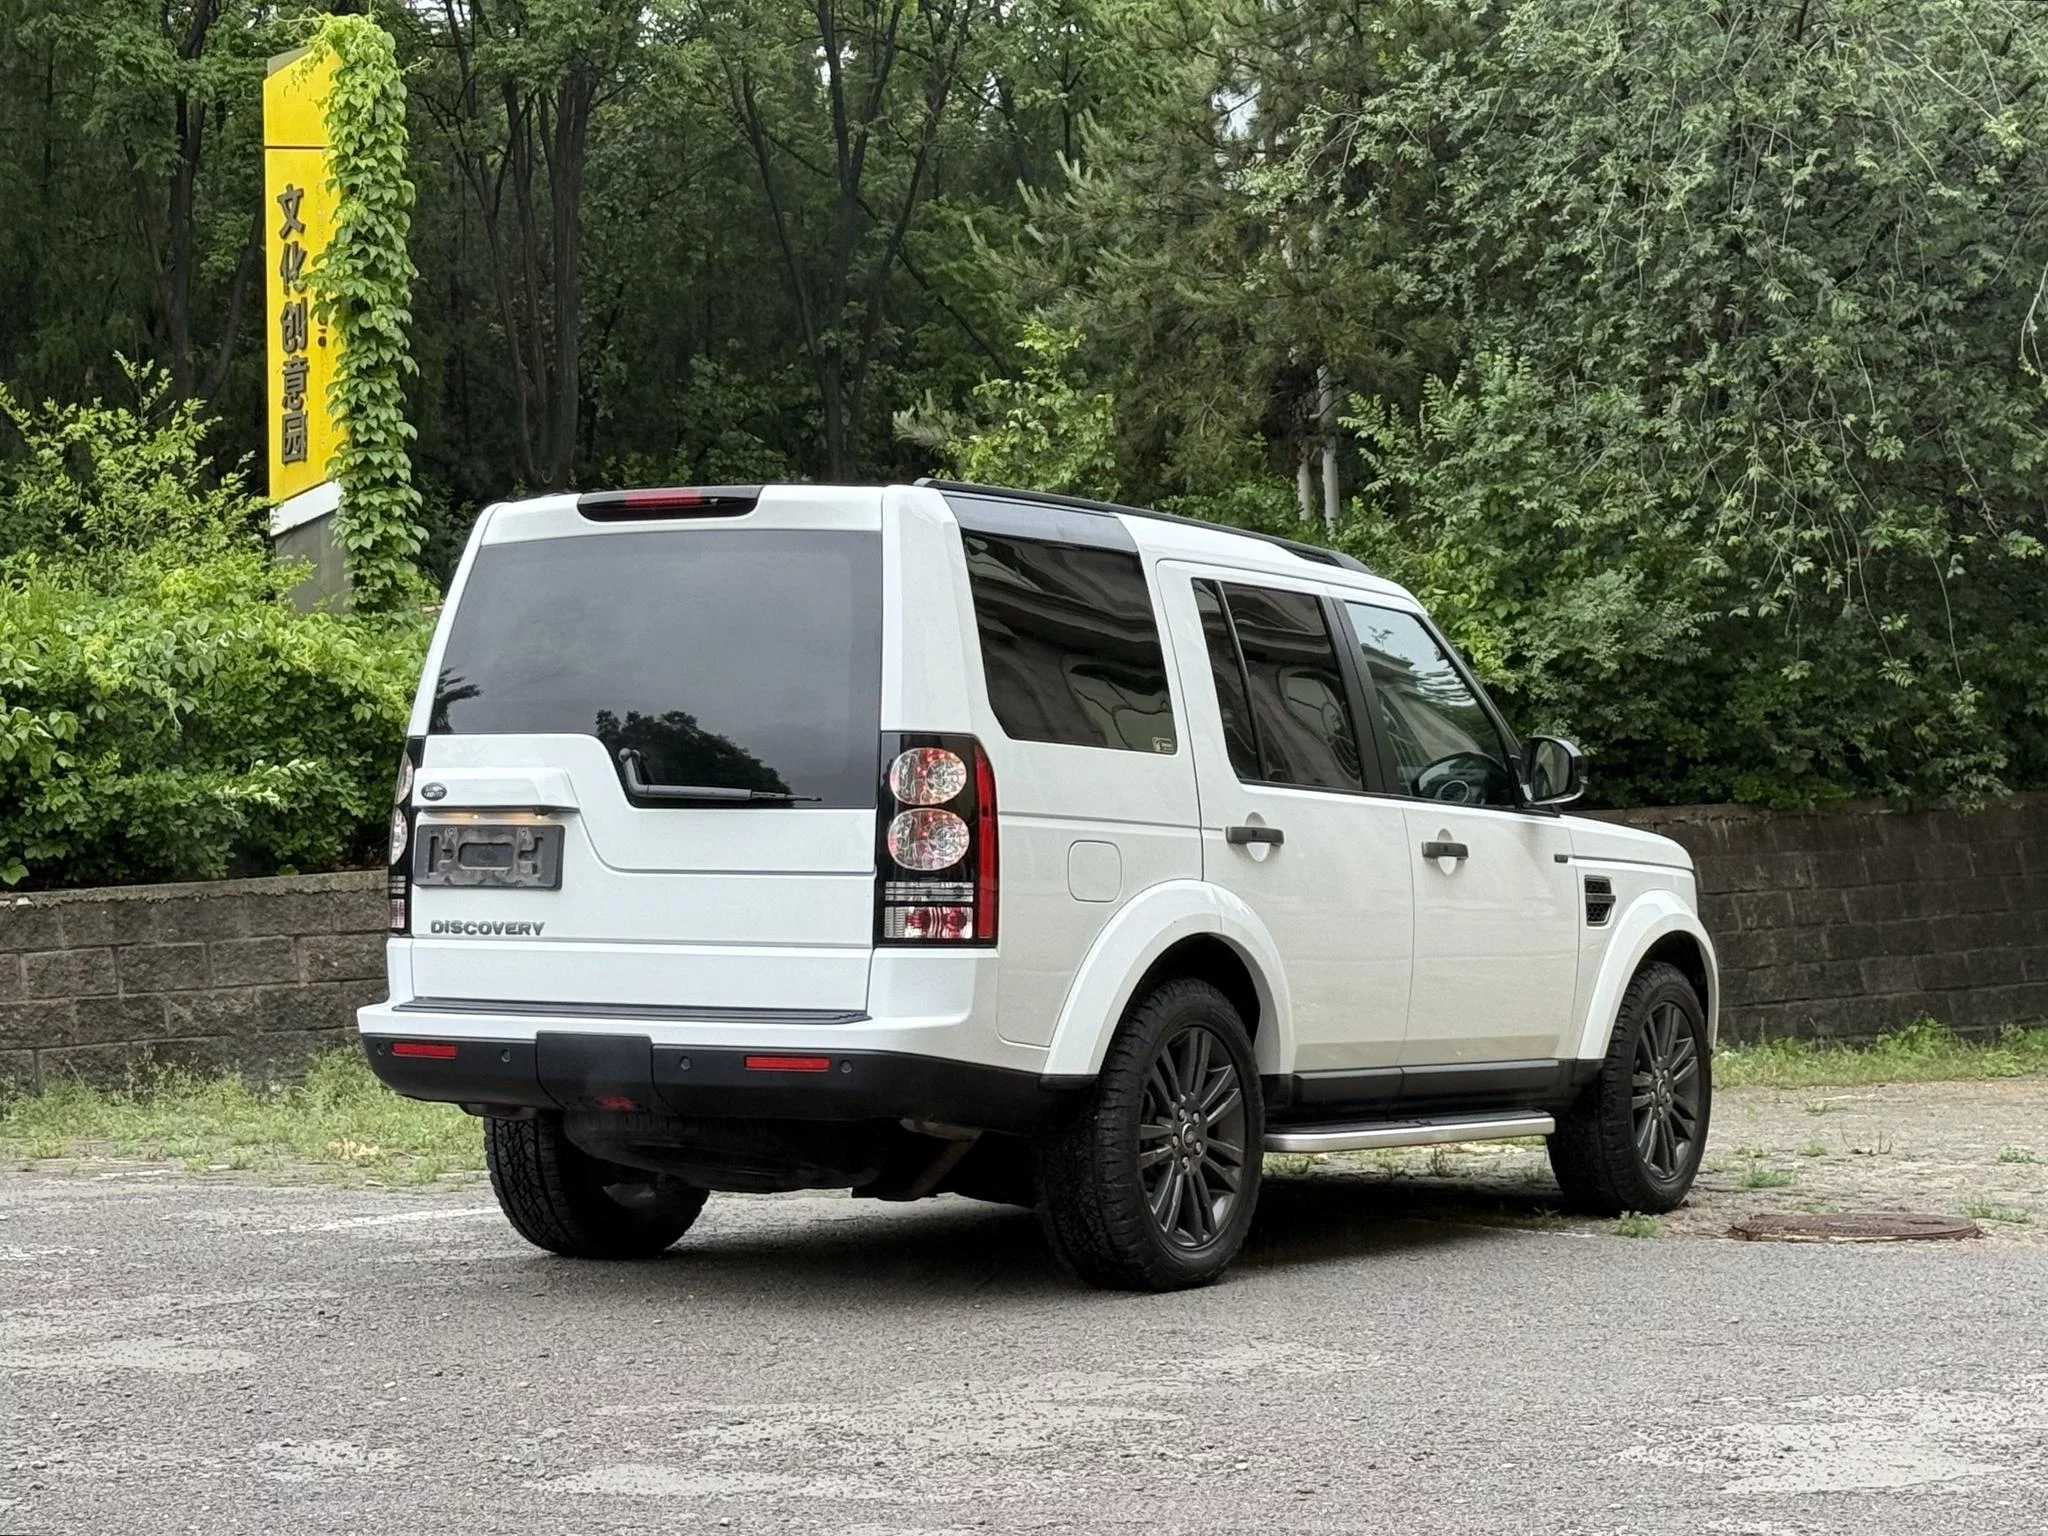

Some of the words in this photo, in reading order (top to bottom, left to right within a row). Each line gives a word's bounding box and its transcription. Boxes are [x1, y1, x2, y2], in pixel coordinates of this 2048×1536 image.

[277, 183, 309, 466] 文化创意园
[430, 919, 546, 936] DISCOVERY
